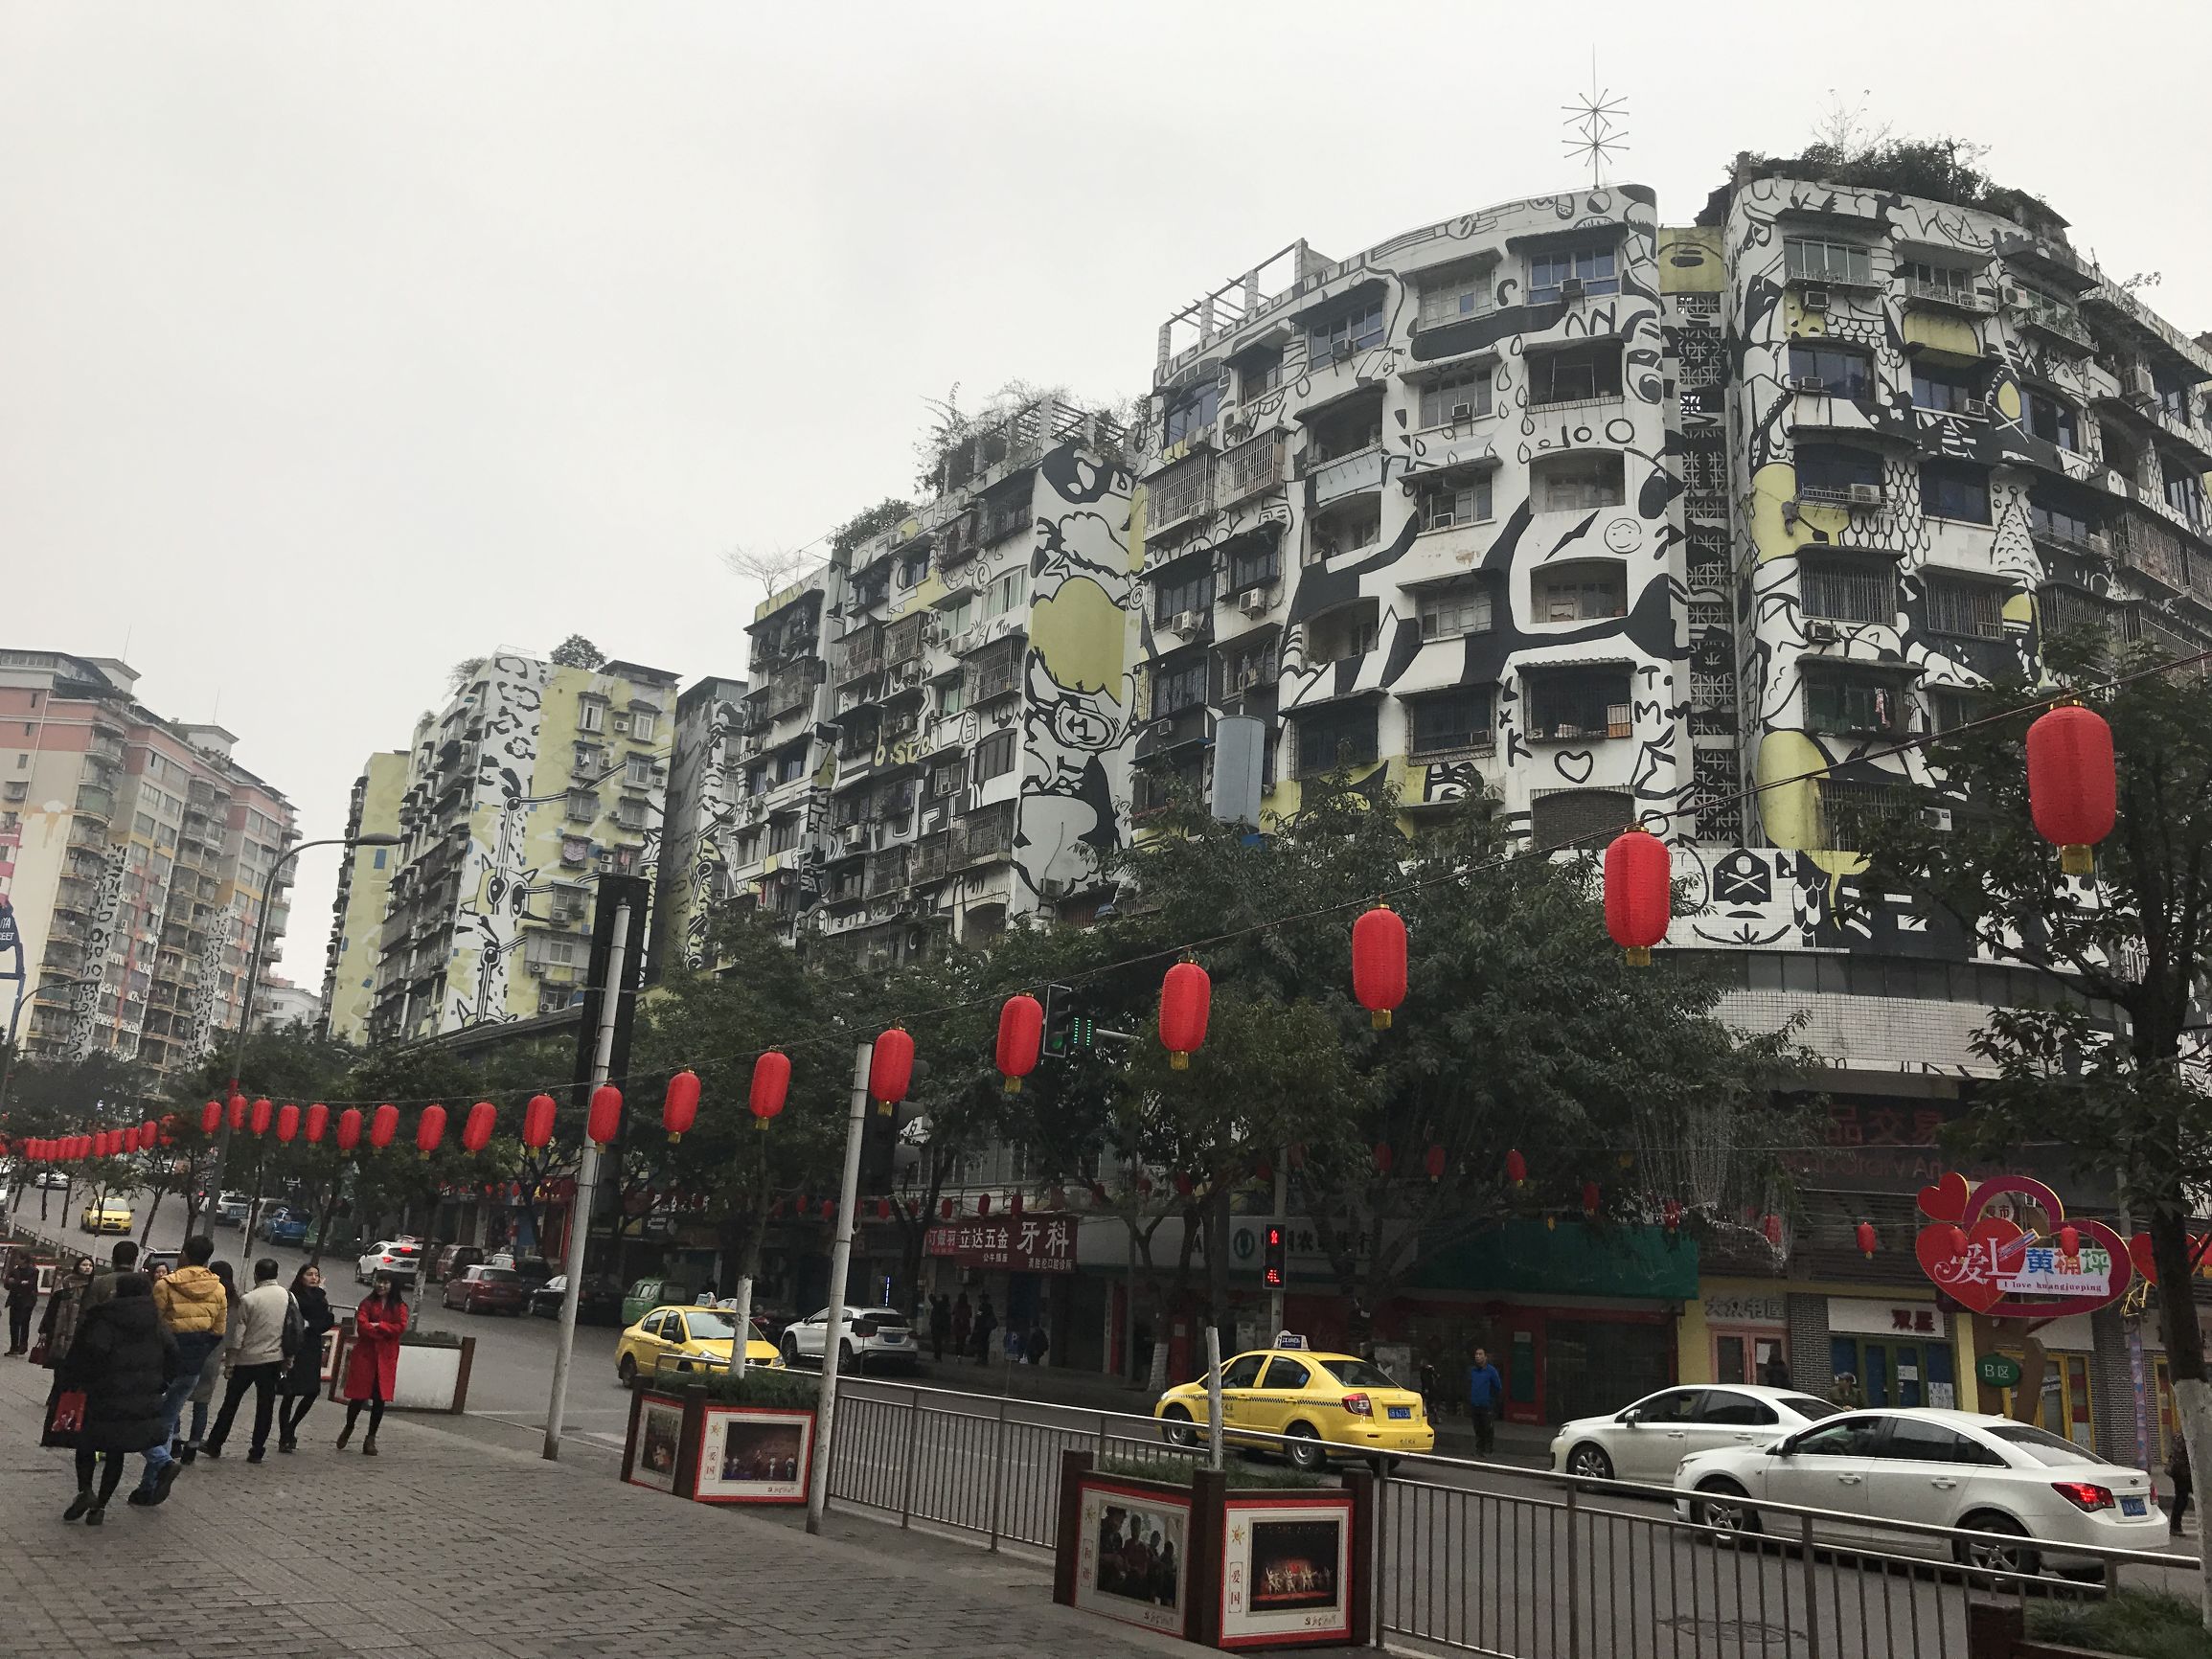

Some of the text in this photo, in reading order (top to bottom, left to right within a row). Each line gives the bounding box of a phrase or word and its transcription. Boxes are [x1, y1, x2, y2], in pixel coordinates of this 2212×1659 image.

[959, 1226, 1009, 1249] 立达五金
[1016, 1219, 1070, 1258] 牙科
[1704, 1296, 1786, 1320] 大众书屋
[1984, 1364, 2010, 1378] B区
